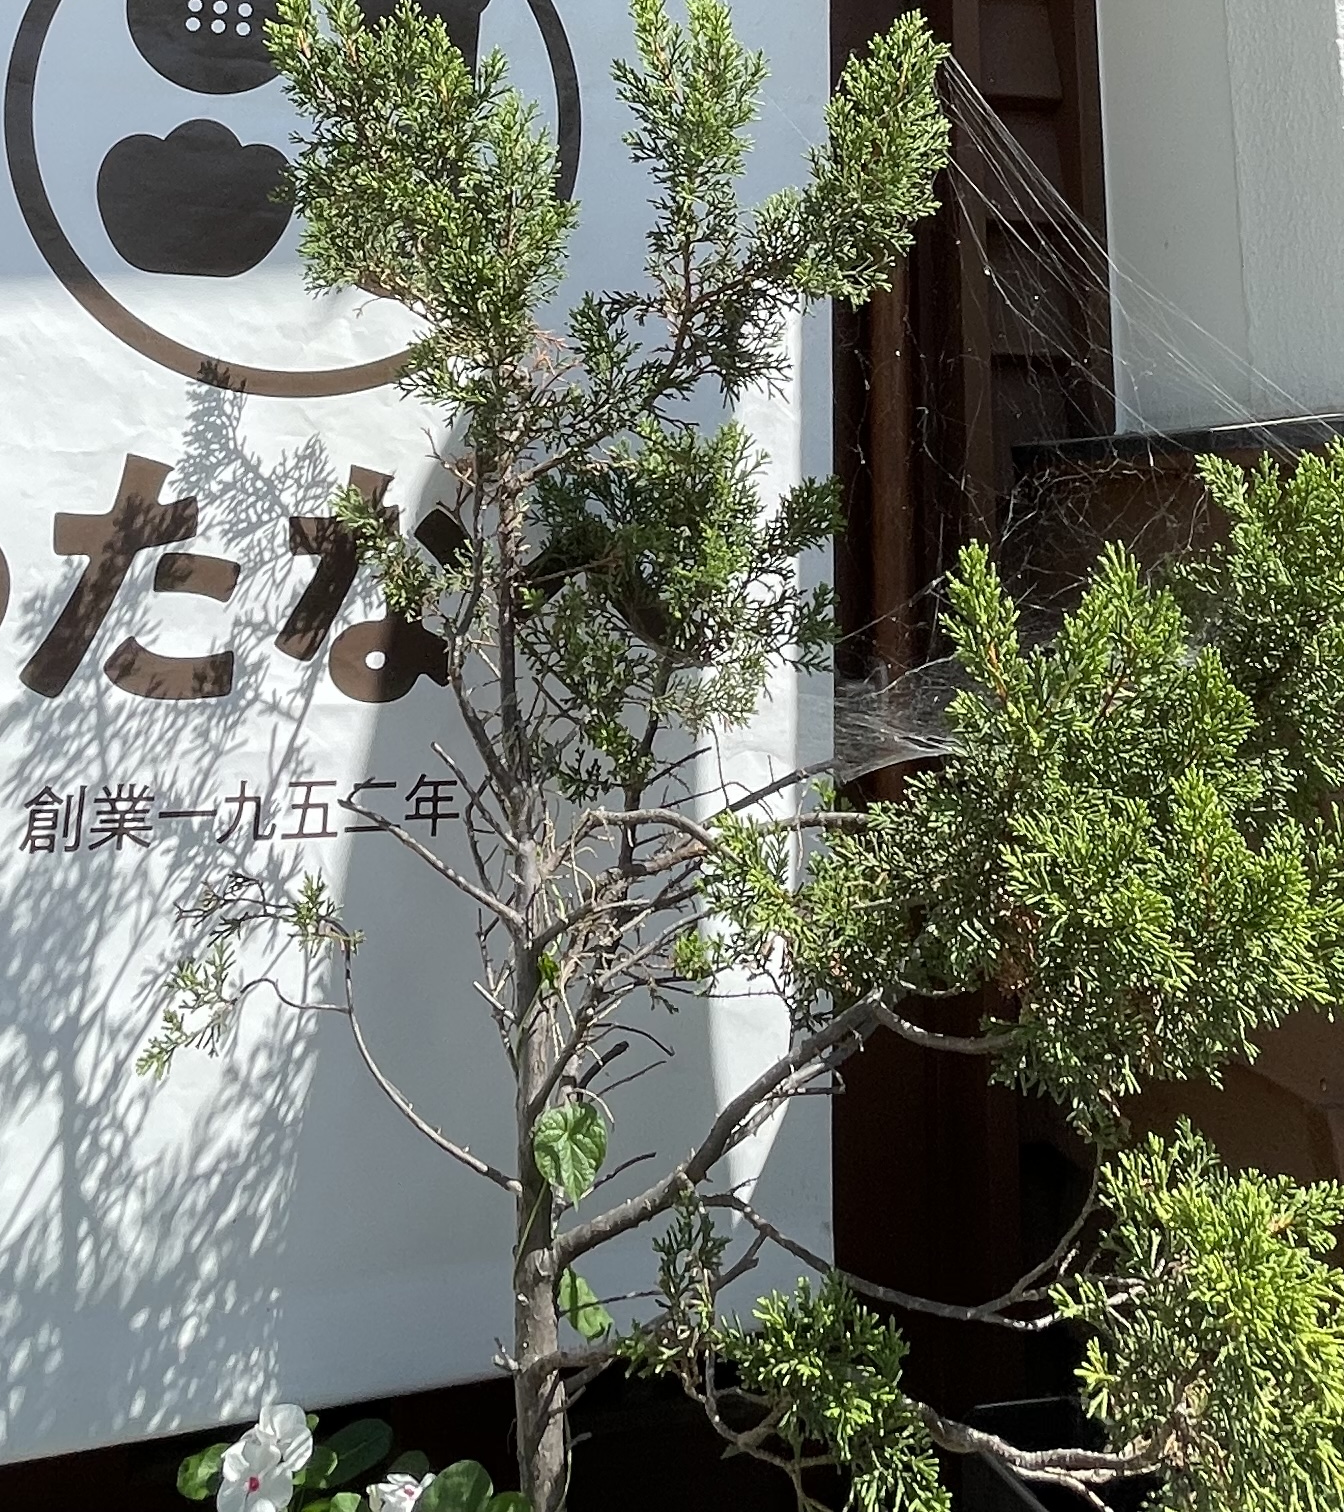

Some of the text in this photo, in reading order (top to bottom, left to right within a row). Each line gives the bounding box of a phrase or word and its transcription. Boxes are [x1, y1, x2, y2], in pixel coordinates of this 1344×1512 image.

[18, 772, 460, 855] 創業一九五二年
